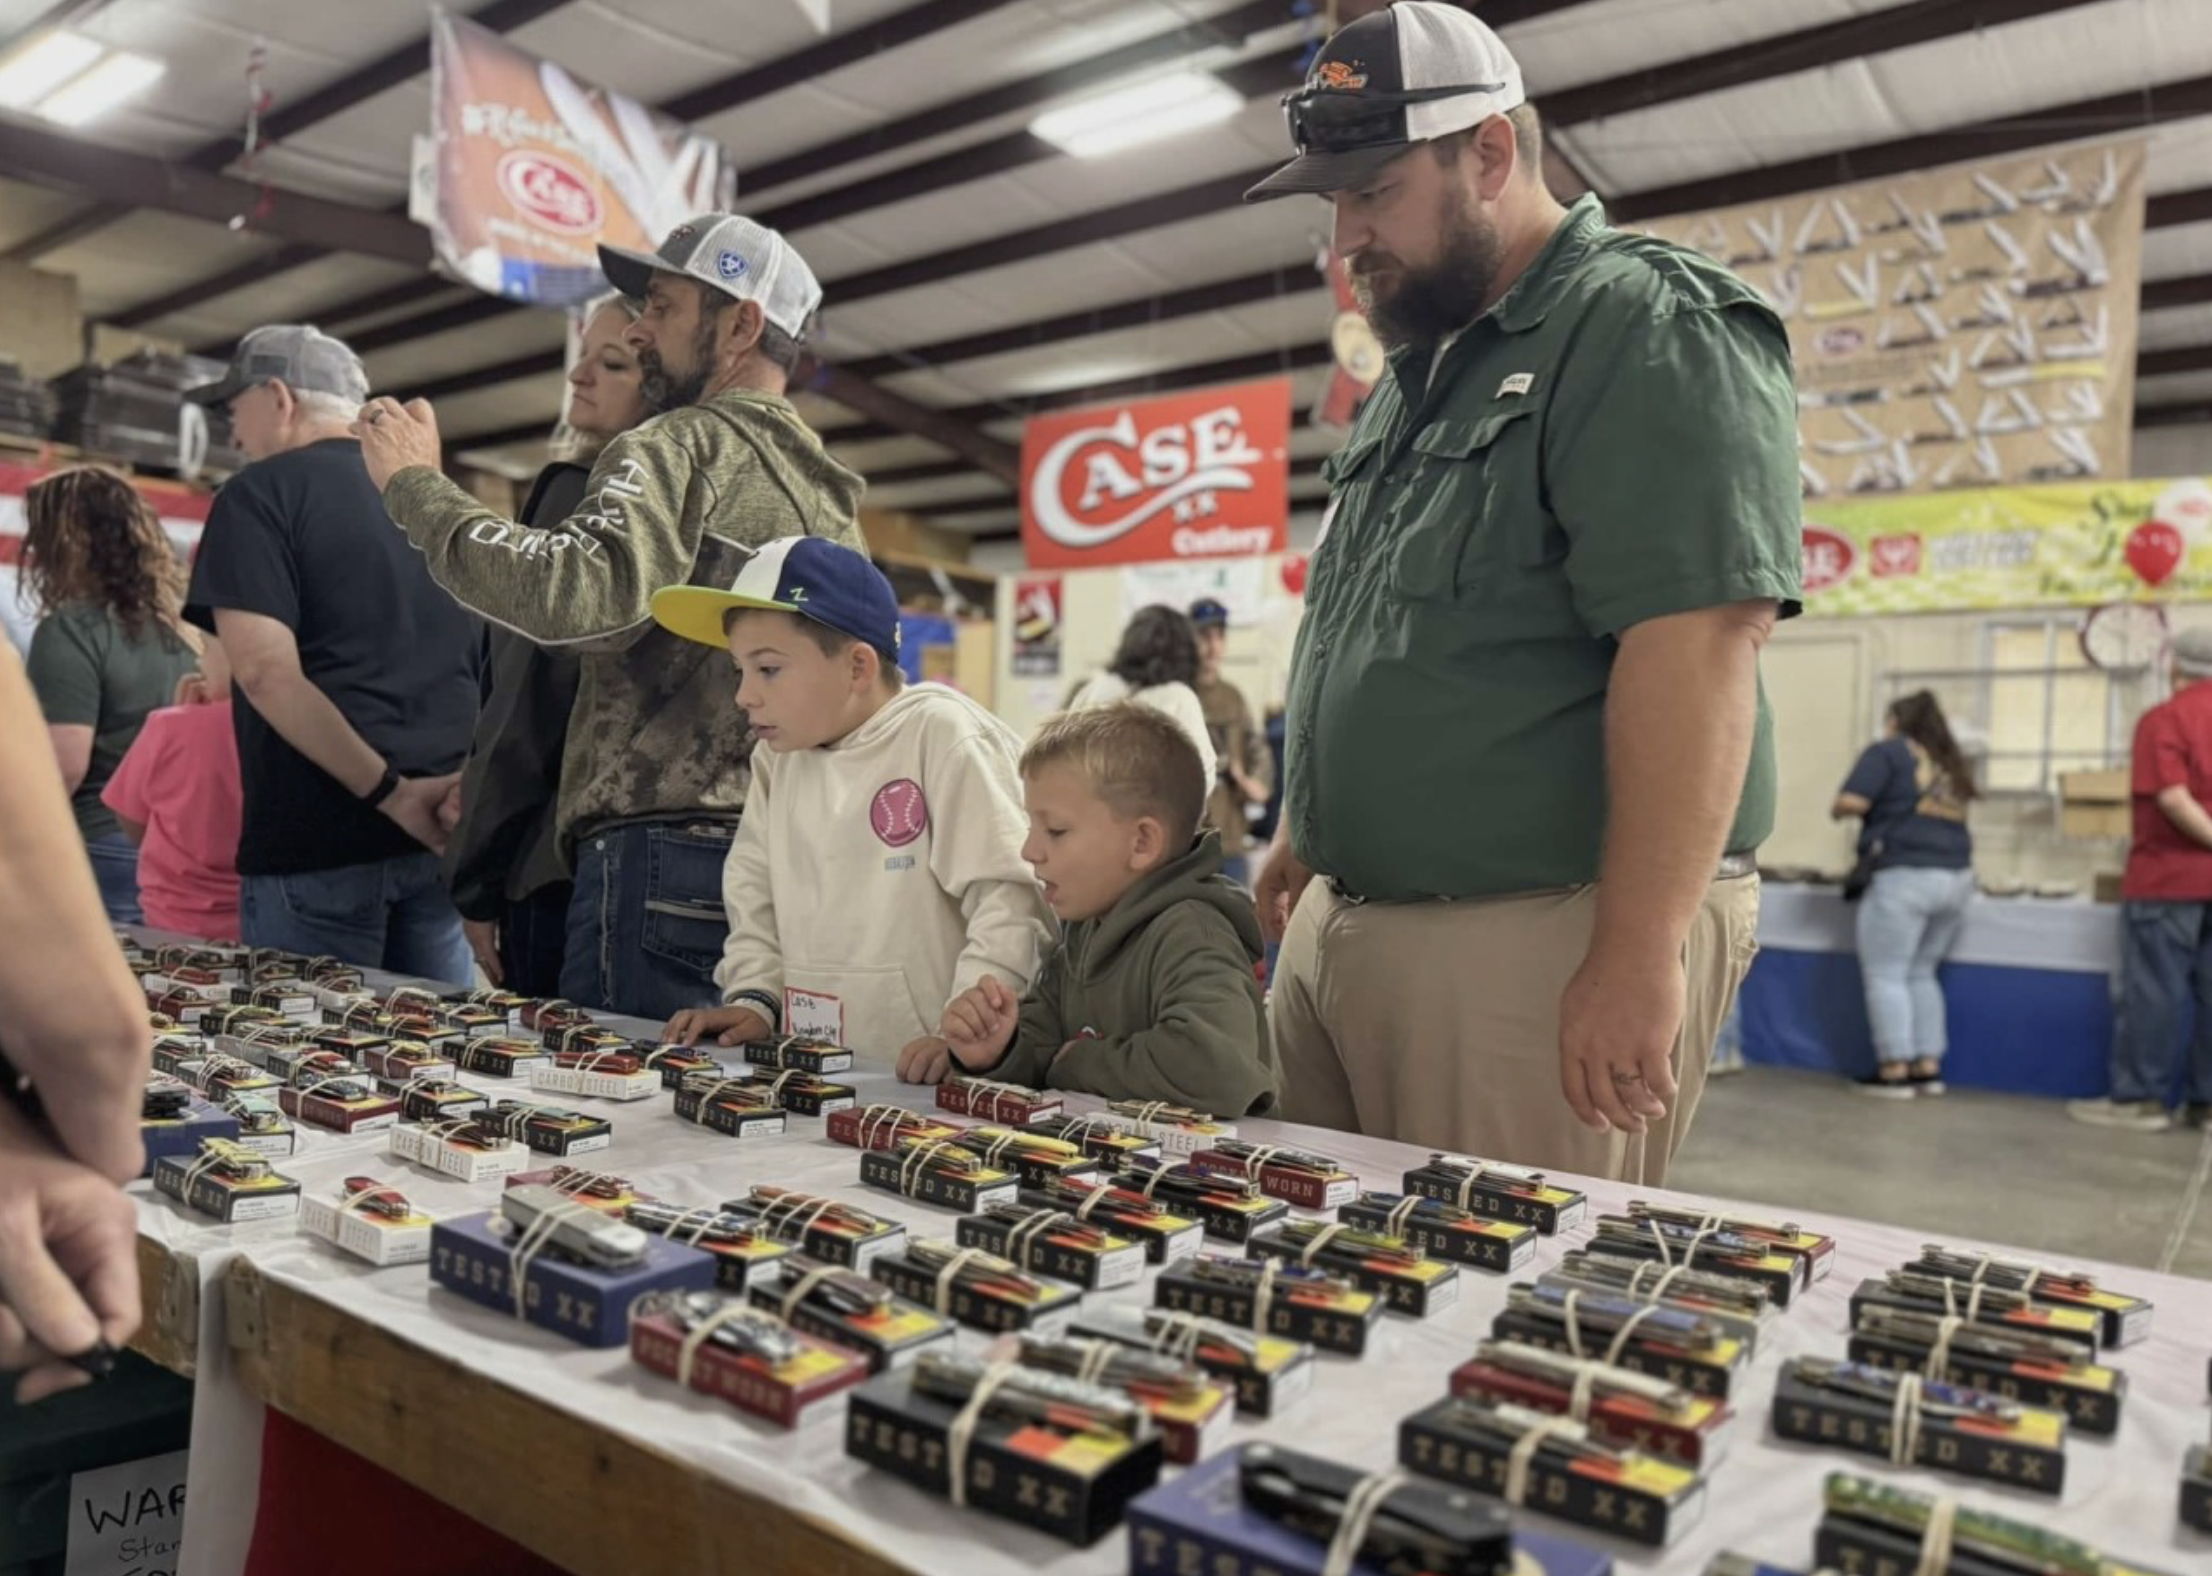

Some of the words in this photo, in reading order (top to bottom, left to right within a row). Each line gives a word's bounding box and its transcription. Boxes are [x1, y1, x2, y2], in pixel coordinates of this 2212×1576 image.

[1031, 405, 1263, 547] CASE
[1171, 526, 1274, 556] Cutlery
[749, 1048, 794, 1063] TESTD
[537, 1071, 574, 1089] CARBO
[941, 1092, 993, 1115] TESED
[1002, 1106, 1022, 1122] XX
[943, 1184, 970, 1204] XX
[1265, 1175, 1314, 1198] WORN
[1412, 1180, 1501, 1212] TESED
[1514, 1204, 1546, 1224] XX
[1210, 1214, 1238, 1233] XX
[1464, 1240, 1499, 1260] XX
[878, 1269, 969, 1314] TESTD
[1167, 1290, 1291, 1329] TESTD
[1311, 1313, 1353, 1340] XX
[853, 1414, 996, 1490] TESTD
[1986, 1449, 2044, 1480] XX
[1593, 1490, 1646, 1528] XX
